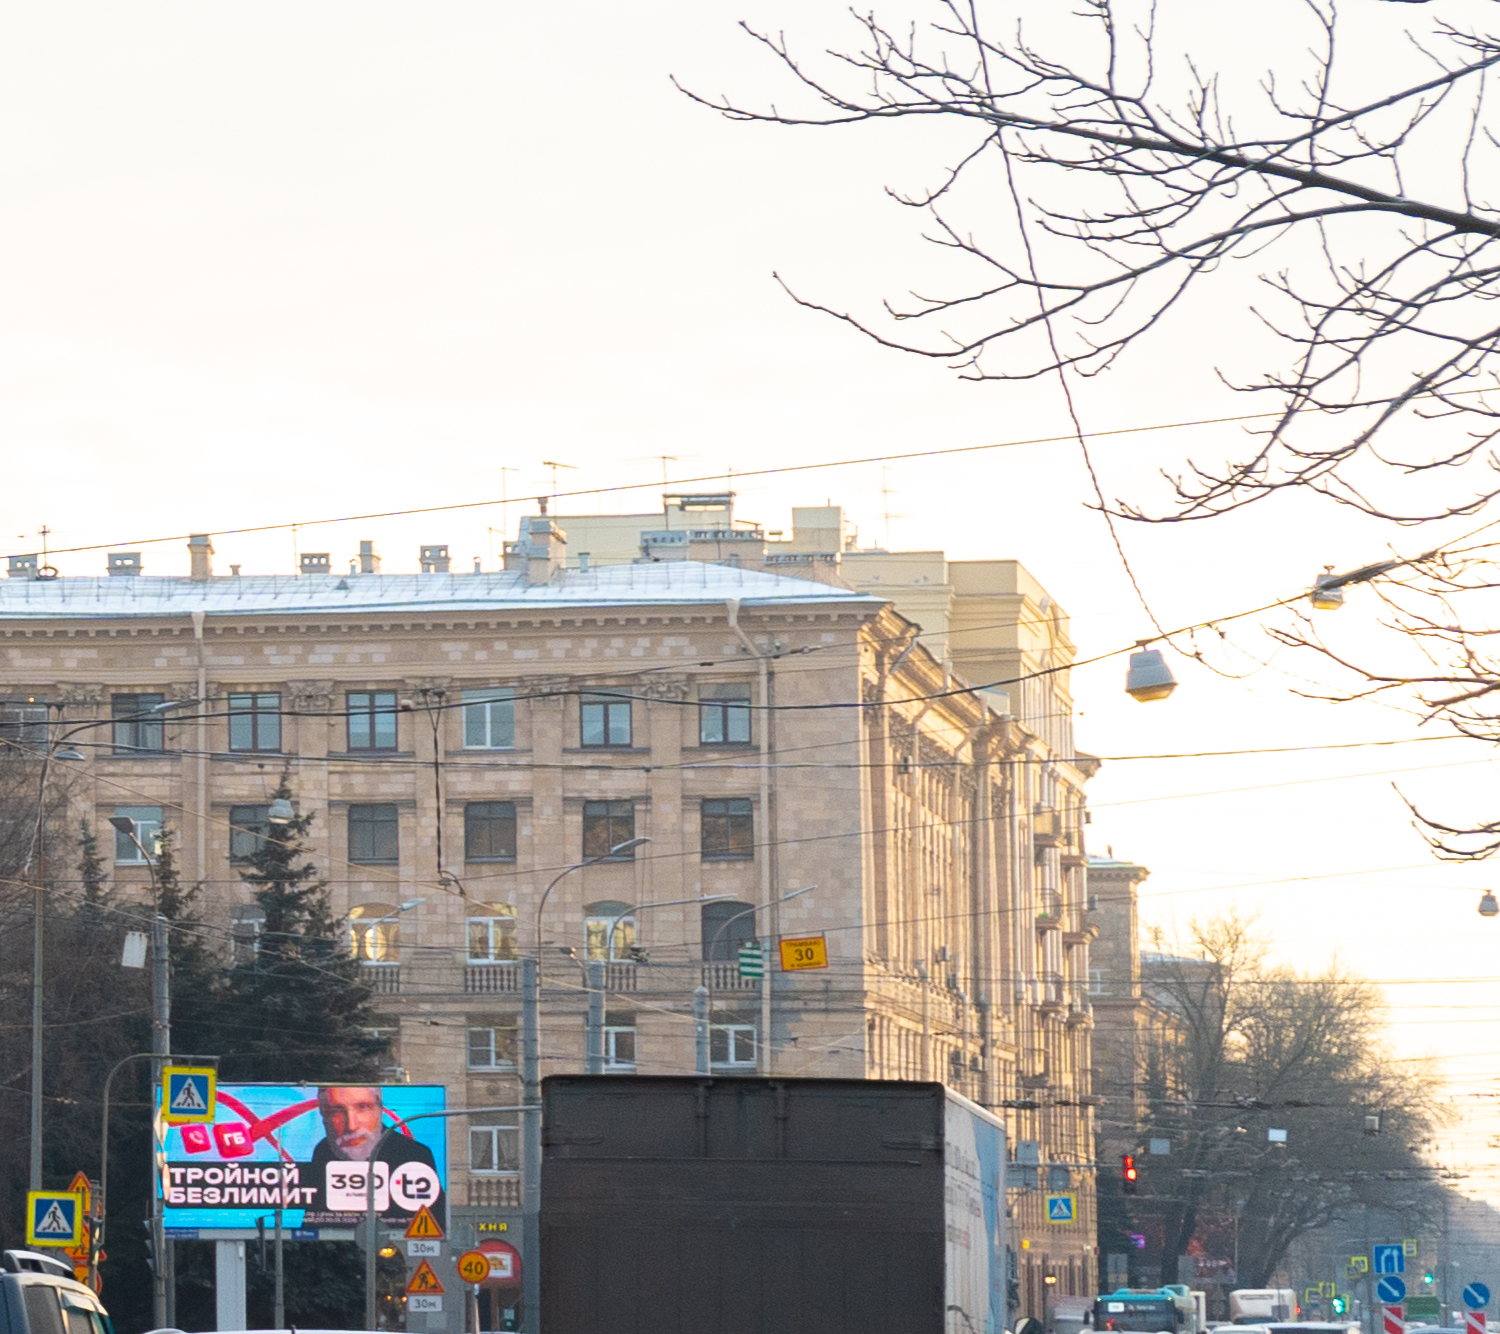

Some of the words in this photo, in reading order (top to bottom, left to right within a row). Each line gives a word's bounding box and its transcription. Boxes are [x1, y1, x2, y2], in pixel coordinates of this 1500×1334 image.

[794, 947, 814, 961] 30
[223, 1132, 245, 1145] ГБ
[169, 1163, 300, 1185] ТРОЙНОЙ
[331, 1174, 384, 1190] 390
[169, 1187, 317, 1204] БЕЗЛИМИТ
[469, 1222, 507, 1232] ХНЯ
[463, 1261, 484, 1275] 40
